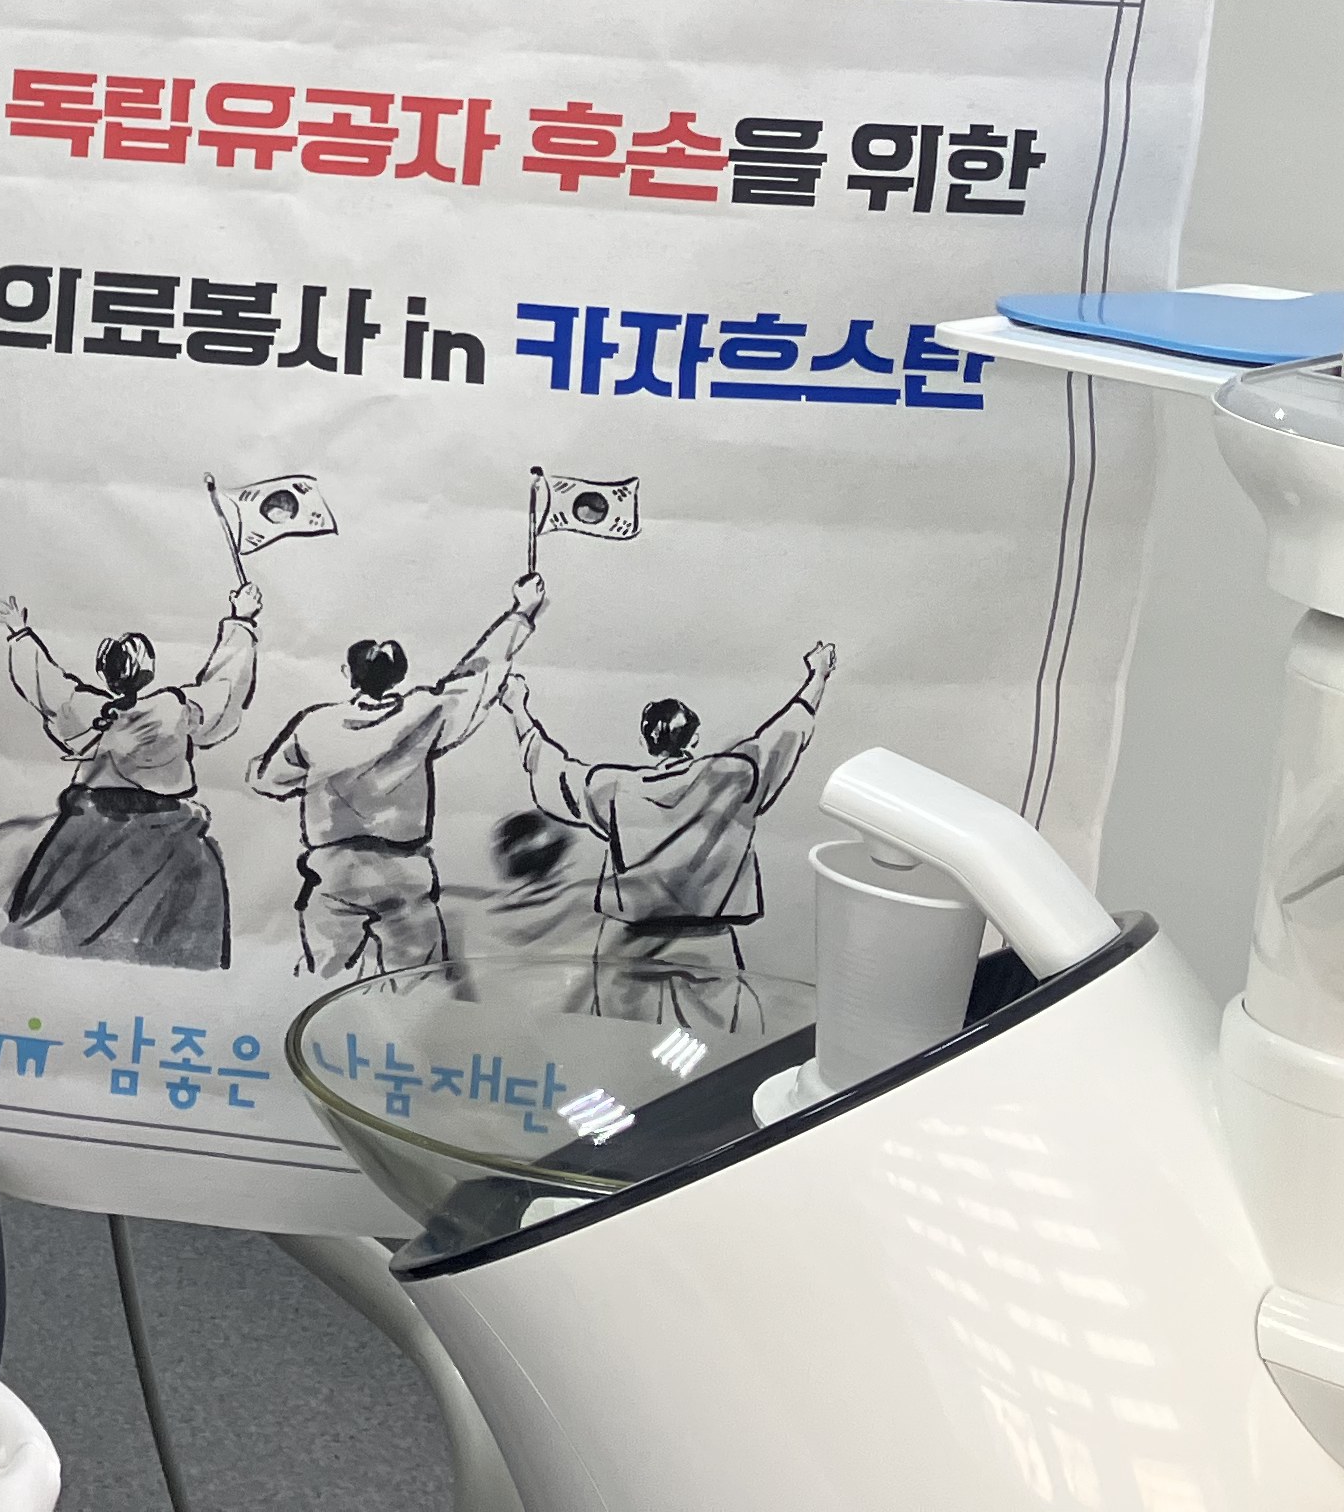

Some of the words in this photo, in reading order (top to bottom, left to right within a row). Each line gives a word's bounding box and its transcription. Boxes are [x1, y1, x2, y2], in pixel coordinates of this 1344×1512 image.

[4, 68, 501, 186] 독립유공자
[522, 101, 828, 207] 후손을
[846, 122, 1047, 216] 위한
[403, 296, 485, 385] in
[515, 302, 996, 411] 카자흐스탄
[83, 1015, 271, 1110] 참좋은
[313, 1033, 567, 1134] 나눔재단
